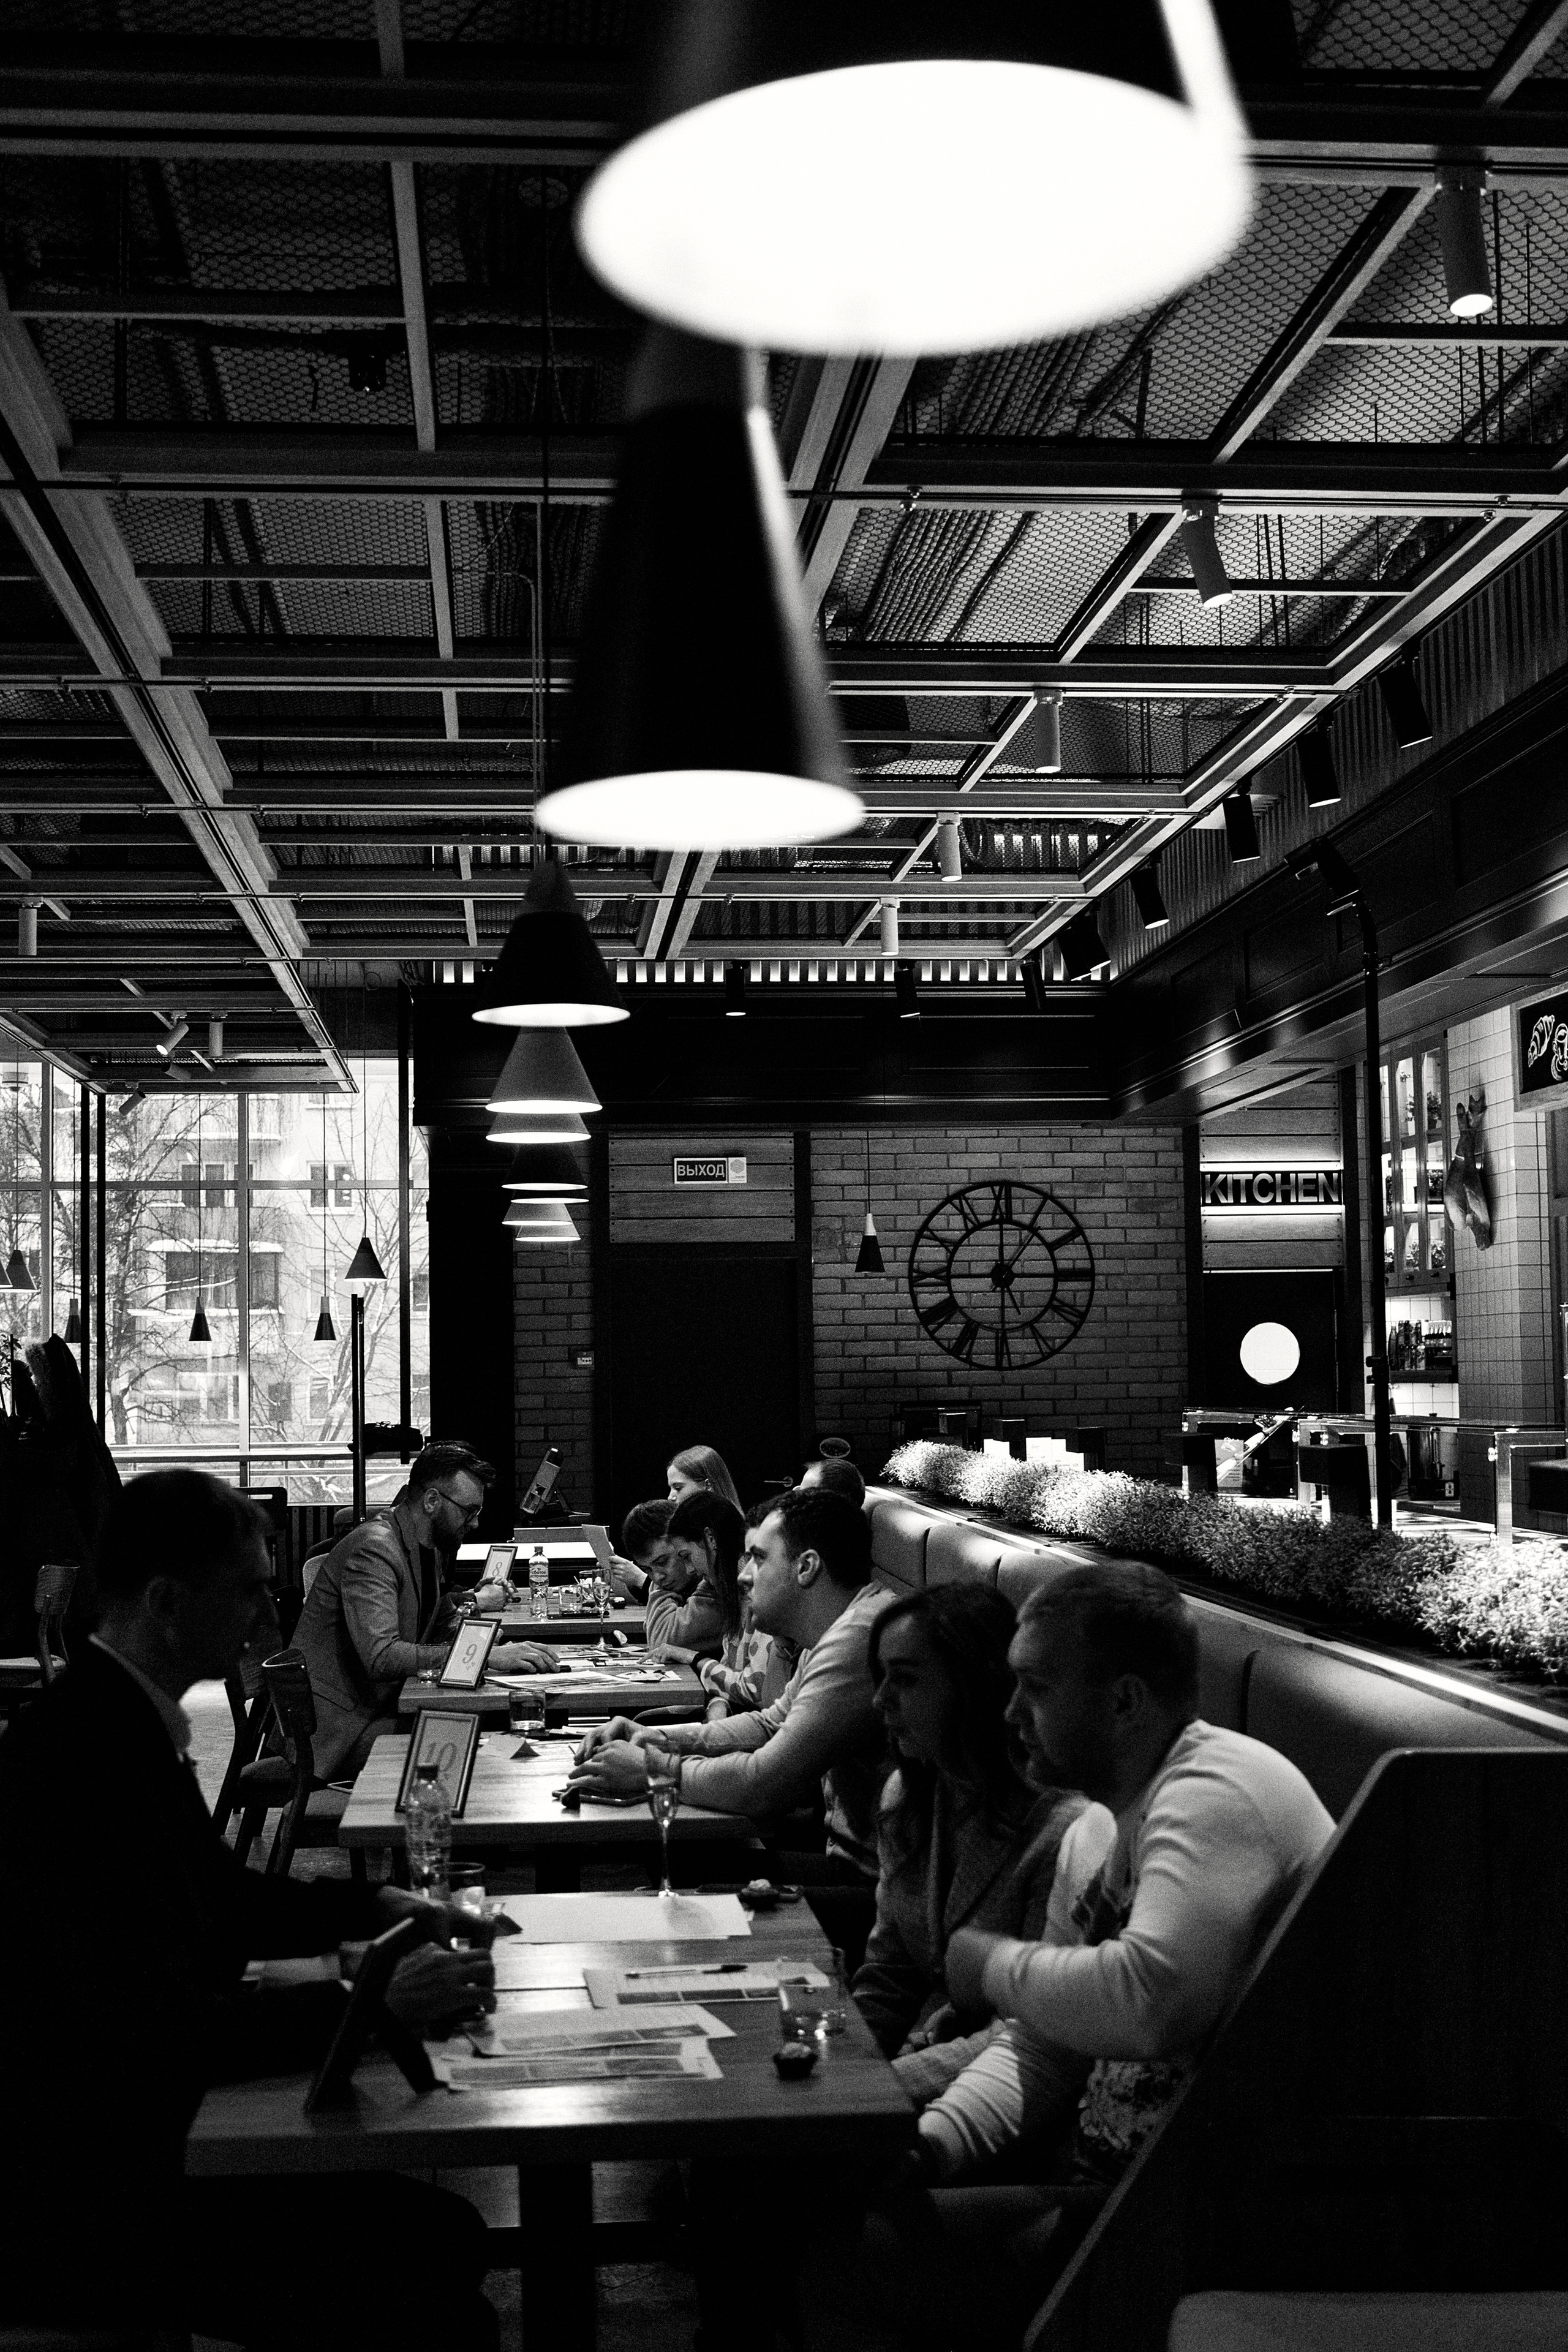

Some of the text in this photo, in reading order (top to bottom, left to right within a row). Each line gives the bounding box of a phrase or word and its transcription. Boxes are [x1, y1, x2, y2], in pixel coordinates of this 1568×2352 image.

[677, 1164, 725, 1178] ВЫХОД
[1205, 1173, 1339, 1204] KITCHEN
[492, 1561, 503, 1577] 8
[462, 1643, 478, 1664] 9
[425, 1742, 458, 1772] 10
